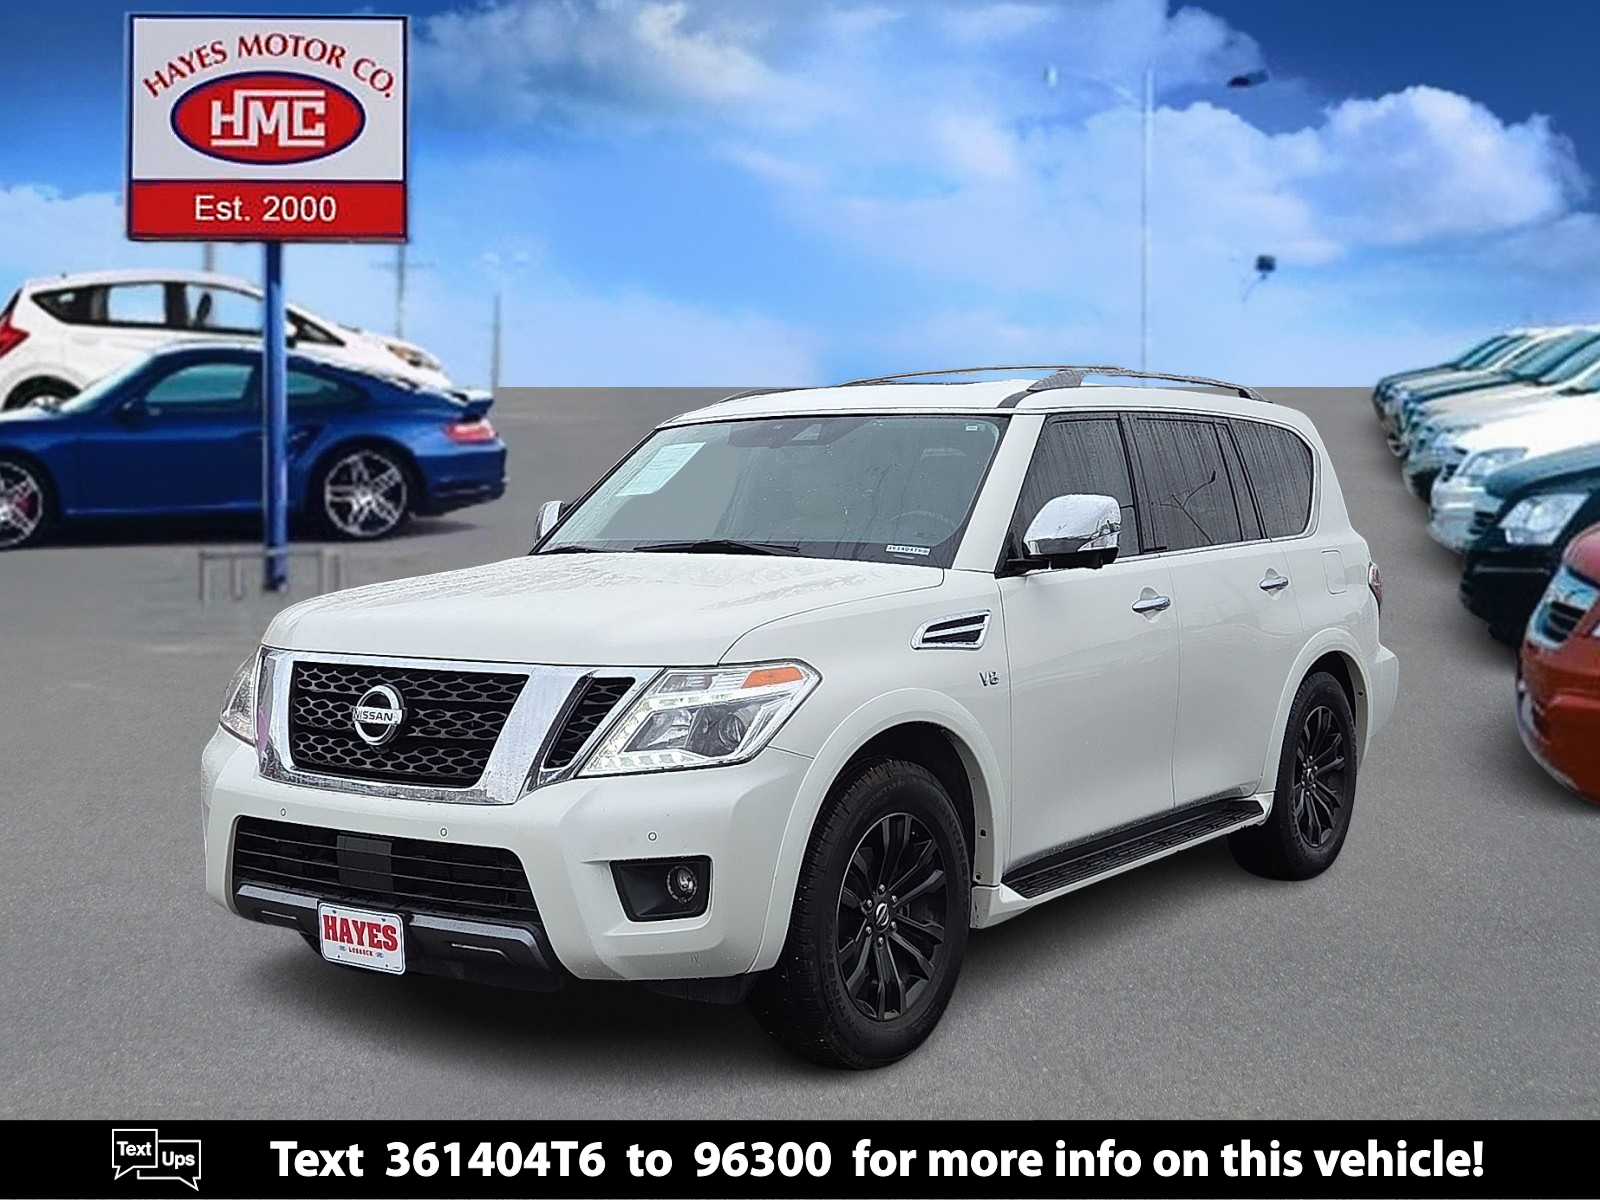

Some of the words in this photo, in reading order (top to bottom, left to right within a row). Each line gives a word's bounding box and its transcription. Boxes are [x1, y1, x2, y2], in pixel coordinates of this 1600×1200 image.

[142, 40, 228, 97] HAYES
[237, 32, 347, 69] MOTOR
[353, 57, 394, 98] CO.
[210, 89, 326, 147] HMC
[194, 194, 251, 221] Est.
[262, 195, 337, 222] 2000
[979, 671, 999, 687] V8
[353, 706, 394, 722] NISSAN
[323, 915, 398, 951] HAYES
